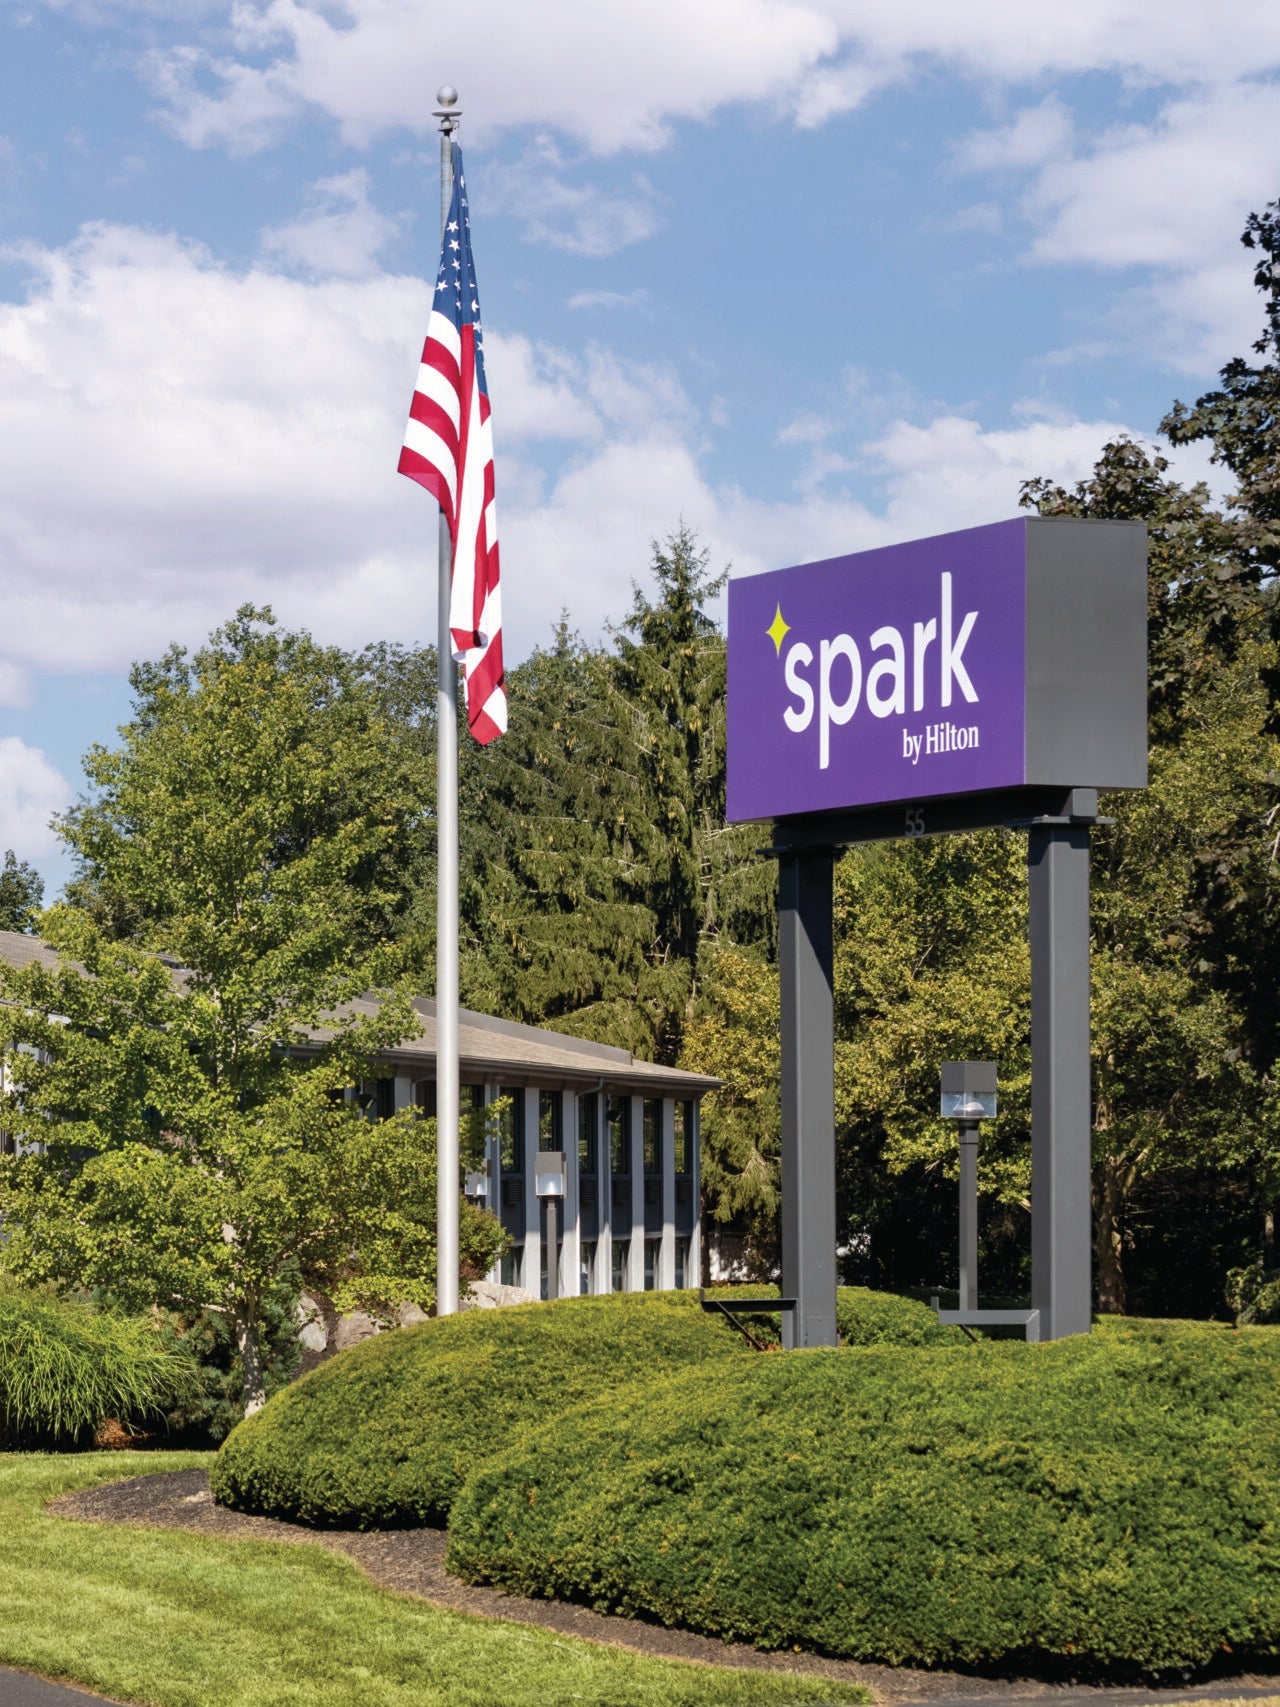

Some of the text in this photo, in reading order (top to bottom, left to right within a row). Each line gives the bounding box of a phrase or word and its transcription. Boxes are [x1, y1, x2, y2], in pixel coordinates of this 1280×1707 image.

[783, 571, 979, 770] spark
[902, 722, 979, 765] by Hilton
[905, 808, 925, 837] 55
